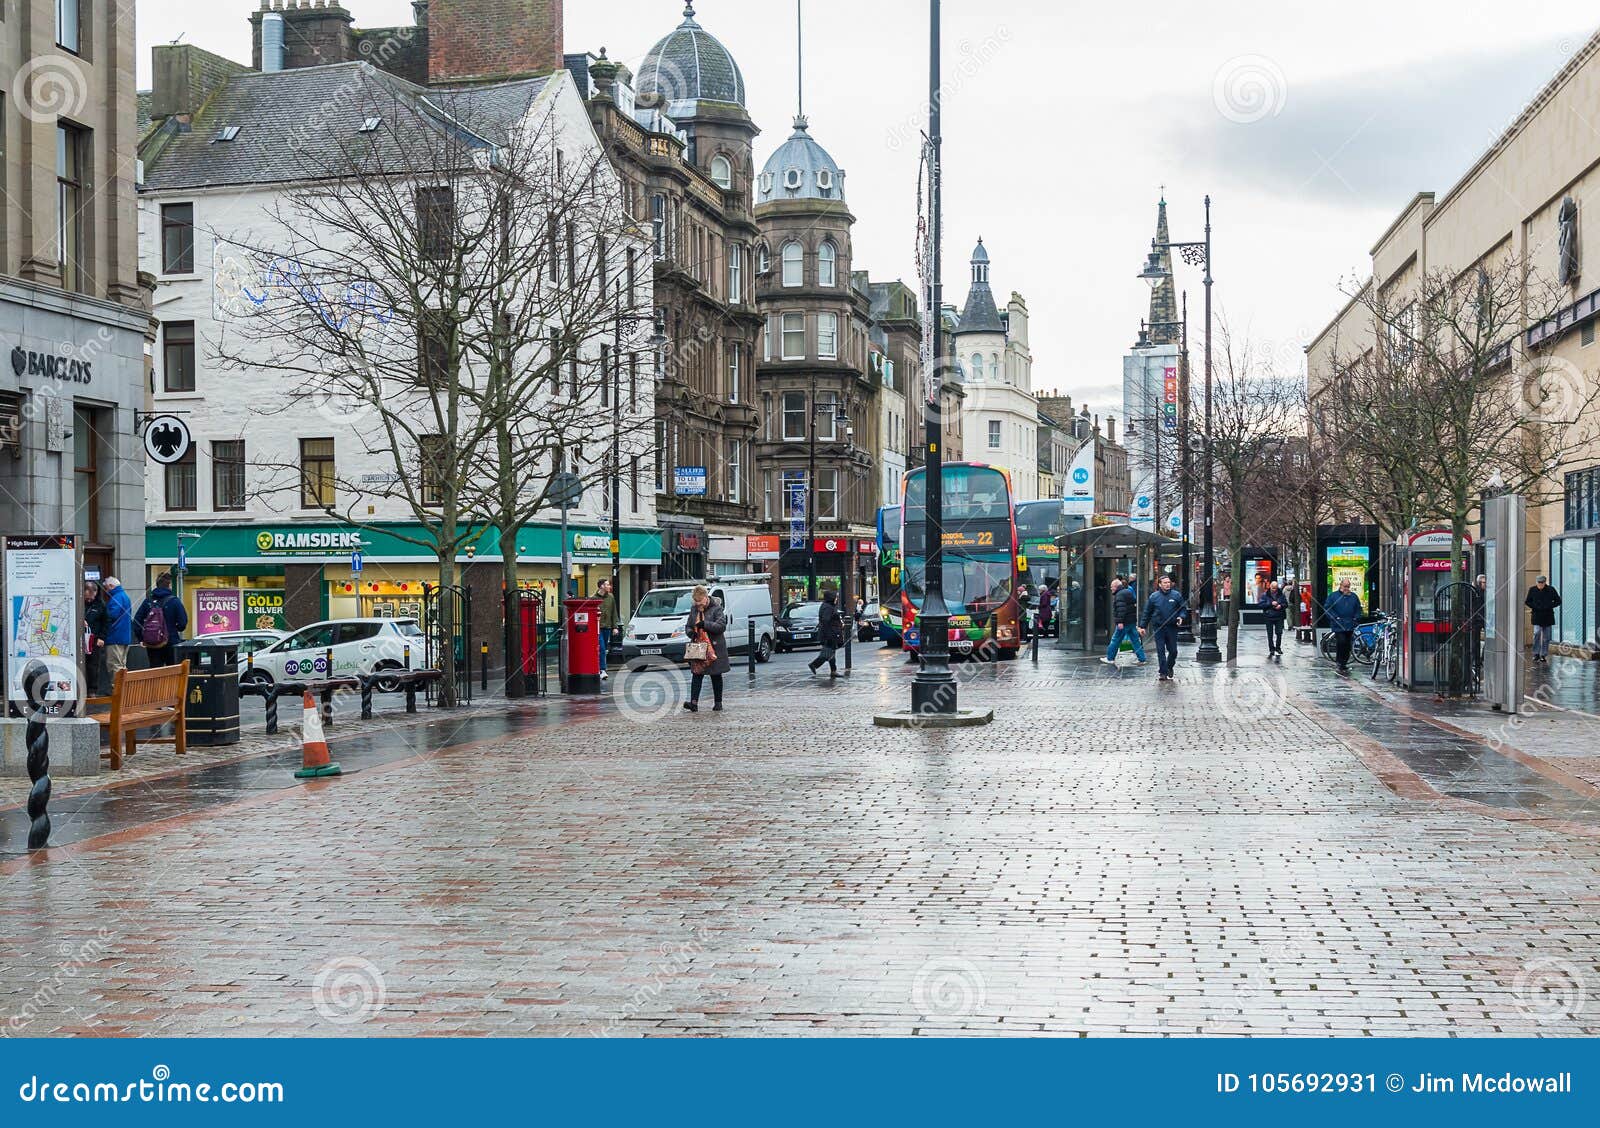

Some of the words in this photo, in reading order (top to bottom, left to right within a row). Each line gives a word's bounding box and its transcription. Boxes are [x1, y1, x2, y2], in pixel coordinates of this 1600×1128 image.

[28, 350, 92, 385] BARCLAYS
[274, 533, 361, 548] RAMSDENS
[977, 531, 993, 545] 22
[199, 601, 238, 611] LOANS
[247, 595, 283, 607] GOLD
[247, 606, 254, 614] &
[254, 606, 284, 614] SILVER
[286, 663, 298, 672] 20
[300, 662, 312, 671] 30
[315, 661, 327, 670] 20
